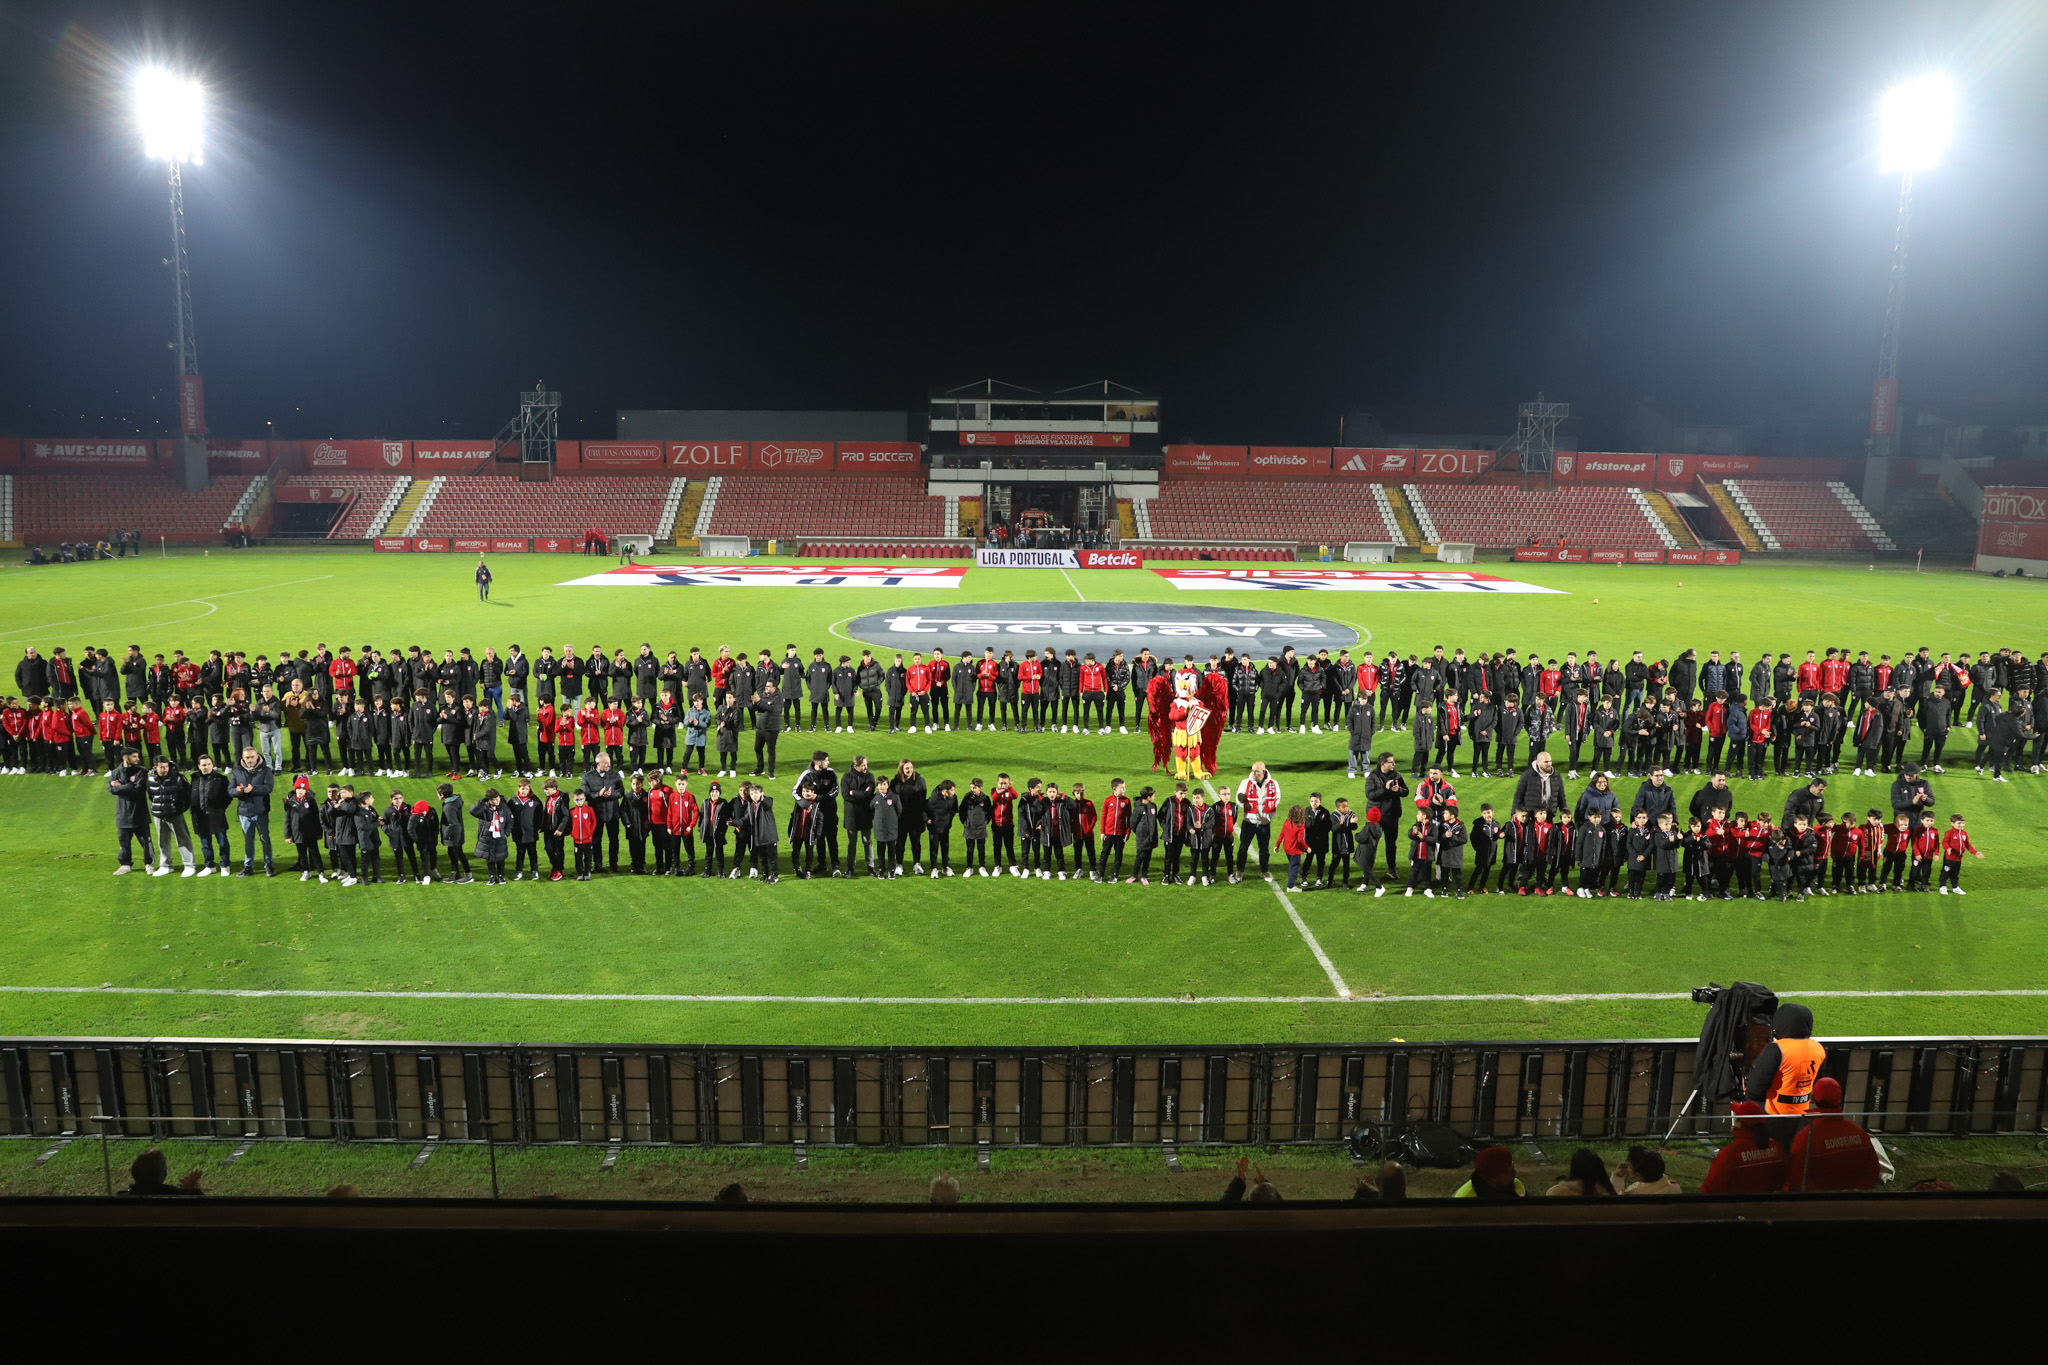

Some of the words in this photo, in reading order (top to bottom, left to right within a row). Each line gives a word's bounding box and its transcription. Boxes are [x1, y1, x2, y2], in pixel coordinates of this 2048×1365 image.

[211, 450, 261, 459] PRIMEIRA
[313, 443, 346, 460] Glow
[418, 450, 441, 459] VILA
[442, 450, 463, 459] DAS
[464, 450, 492, 459] AVES
[588, 449, 618, 457] FRUTAS
[620, 449, 657, 457] ANDRADE
[672, 445, 742, 465] ZOLF
[784, 448, 824, 463] TRP
[841, 452, 865, 462] PRO
[869, 452, 914, 462] SOCCER
[1253, 454, 1308, 466] optivisão
[1421, 454, 1490, 474] ZOLF
[1585, 461, 1646, 472] afsstore.pt
[982, 551, 1008, 566] LIGA
[1010, 551, 1065, 566] PORTUGAL
[1087, 552, 1138, 567] Betclic
[884, 615, 1328, 639] tectoave
[1189, 706, 1209, 732] AFS
[1824, 1134, 1862, 1149] BOMBEIROS
